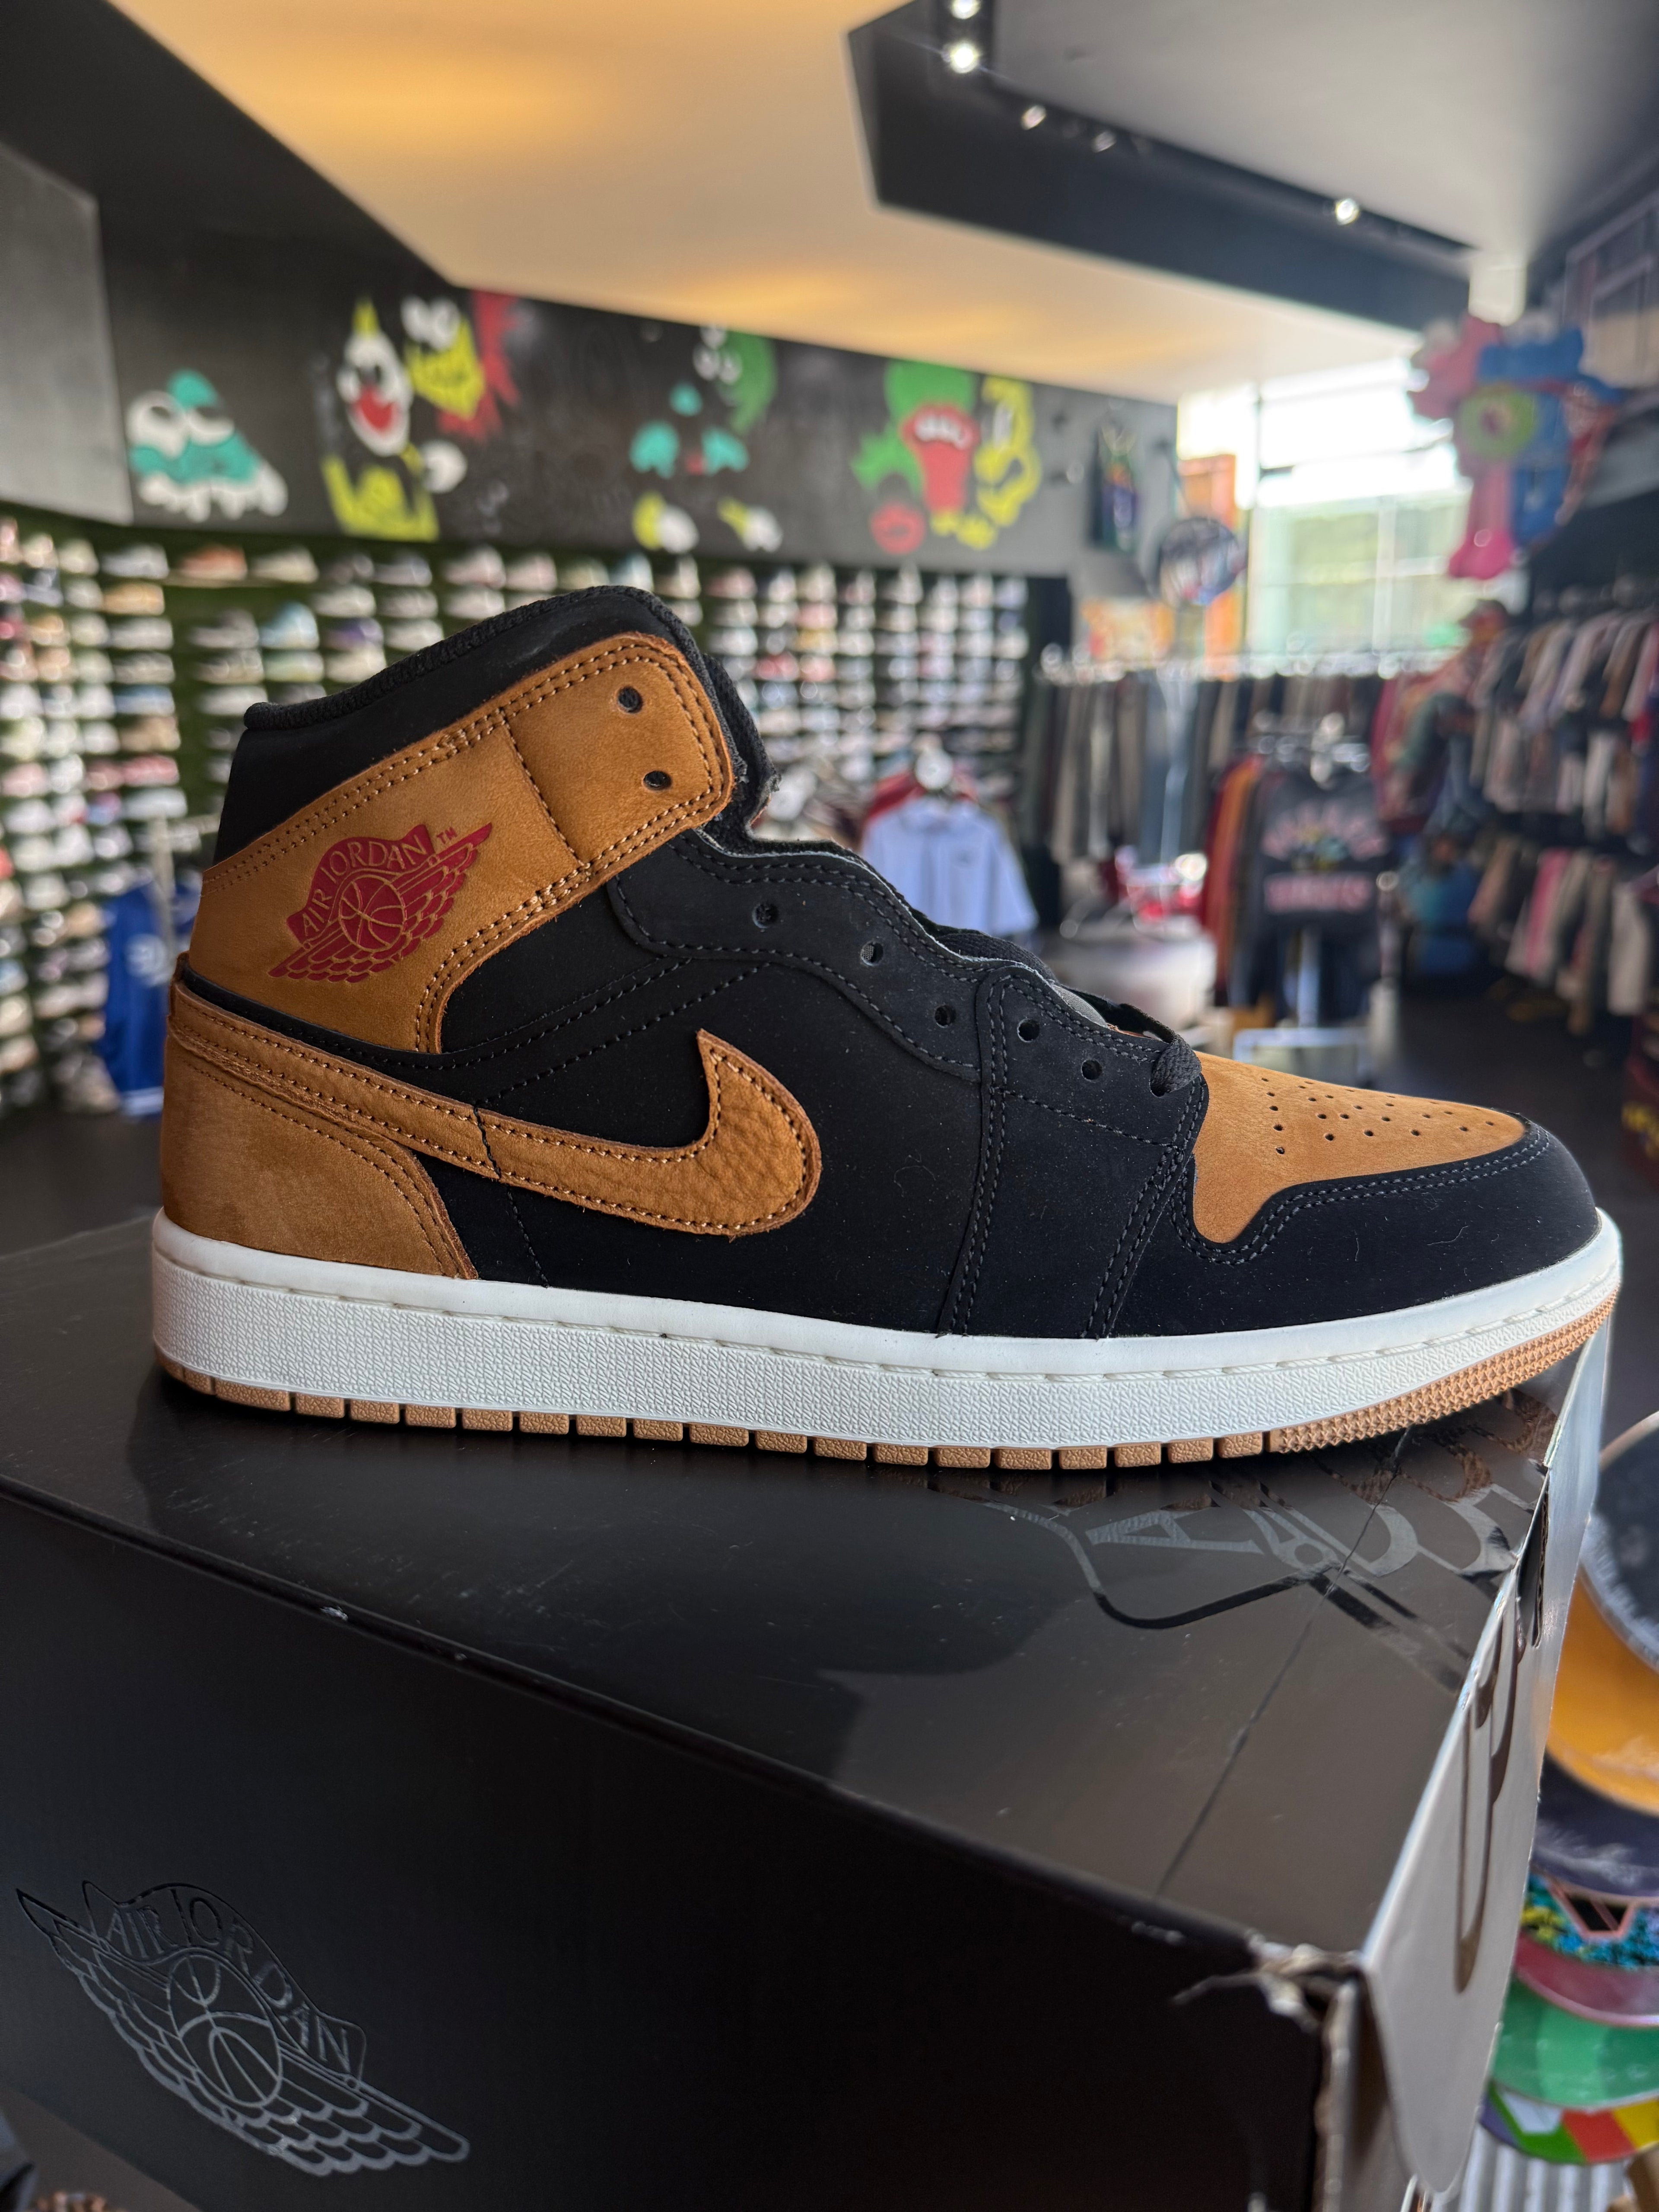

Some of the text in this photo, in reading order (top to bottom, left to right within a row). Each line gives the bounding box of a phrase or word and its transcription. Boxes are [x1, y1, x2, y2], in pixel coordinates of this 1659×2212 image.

[302, 888, 333, 937] AIR
[436, 826, 458, 845] TM
[105, 1904, 178, 1959] AIR
